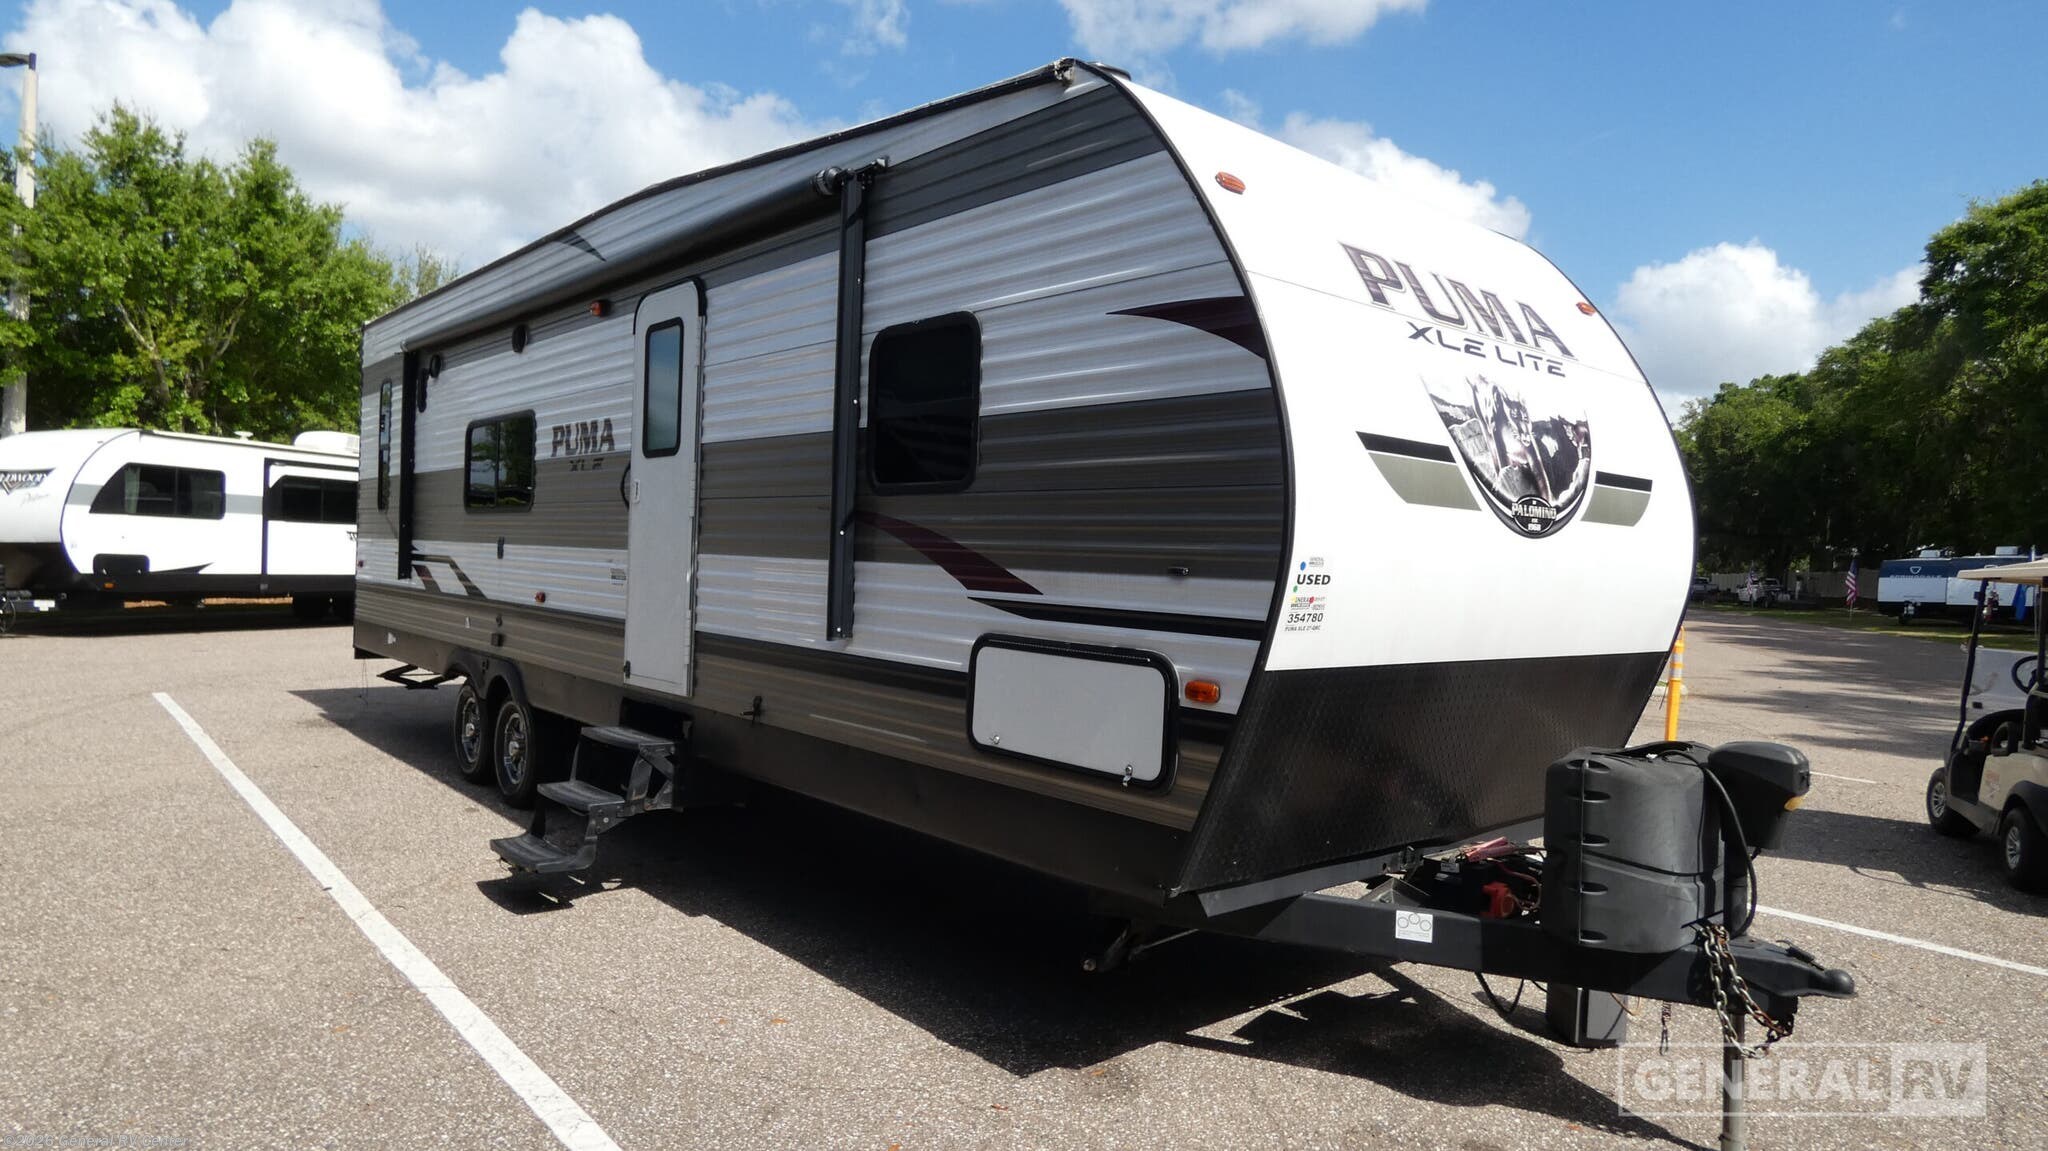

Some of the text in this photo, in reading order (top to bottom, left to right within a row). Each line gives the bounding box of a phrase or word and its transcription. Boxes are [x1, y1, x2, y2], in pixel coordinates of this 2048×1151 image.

[1338, 240, 1579, 362] PUMA
[1407, 321, 1566, 378] XLE LITE
[551, 418, 616, 457] PUMA
[1511, 502, 1557, 520] PALOMINO
[1296, 574, 1331, 586] USED
[1287, 612, 1324, 624] 354780
